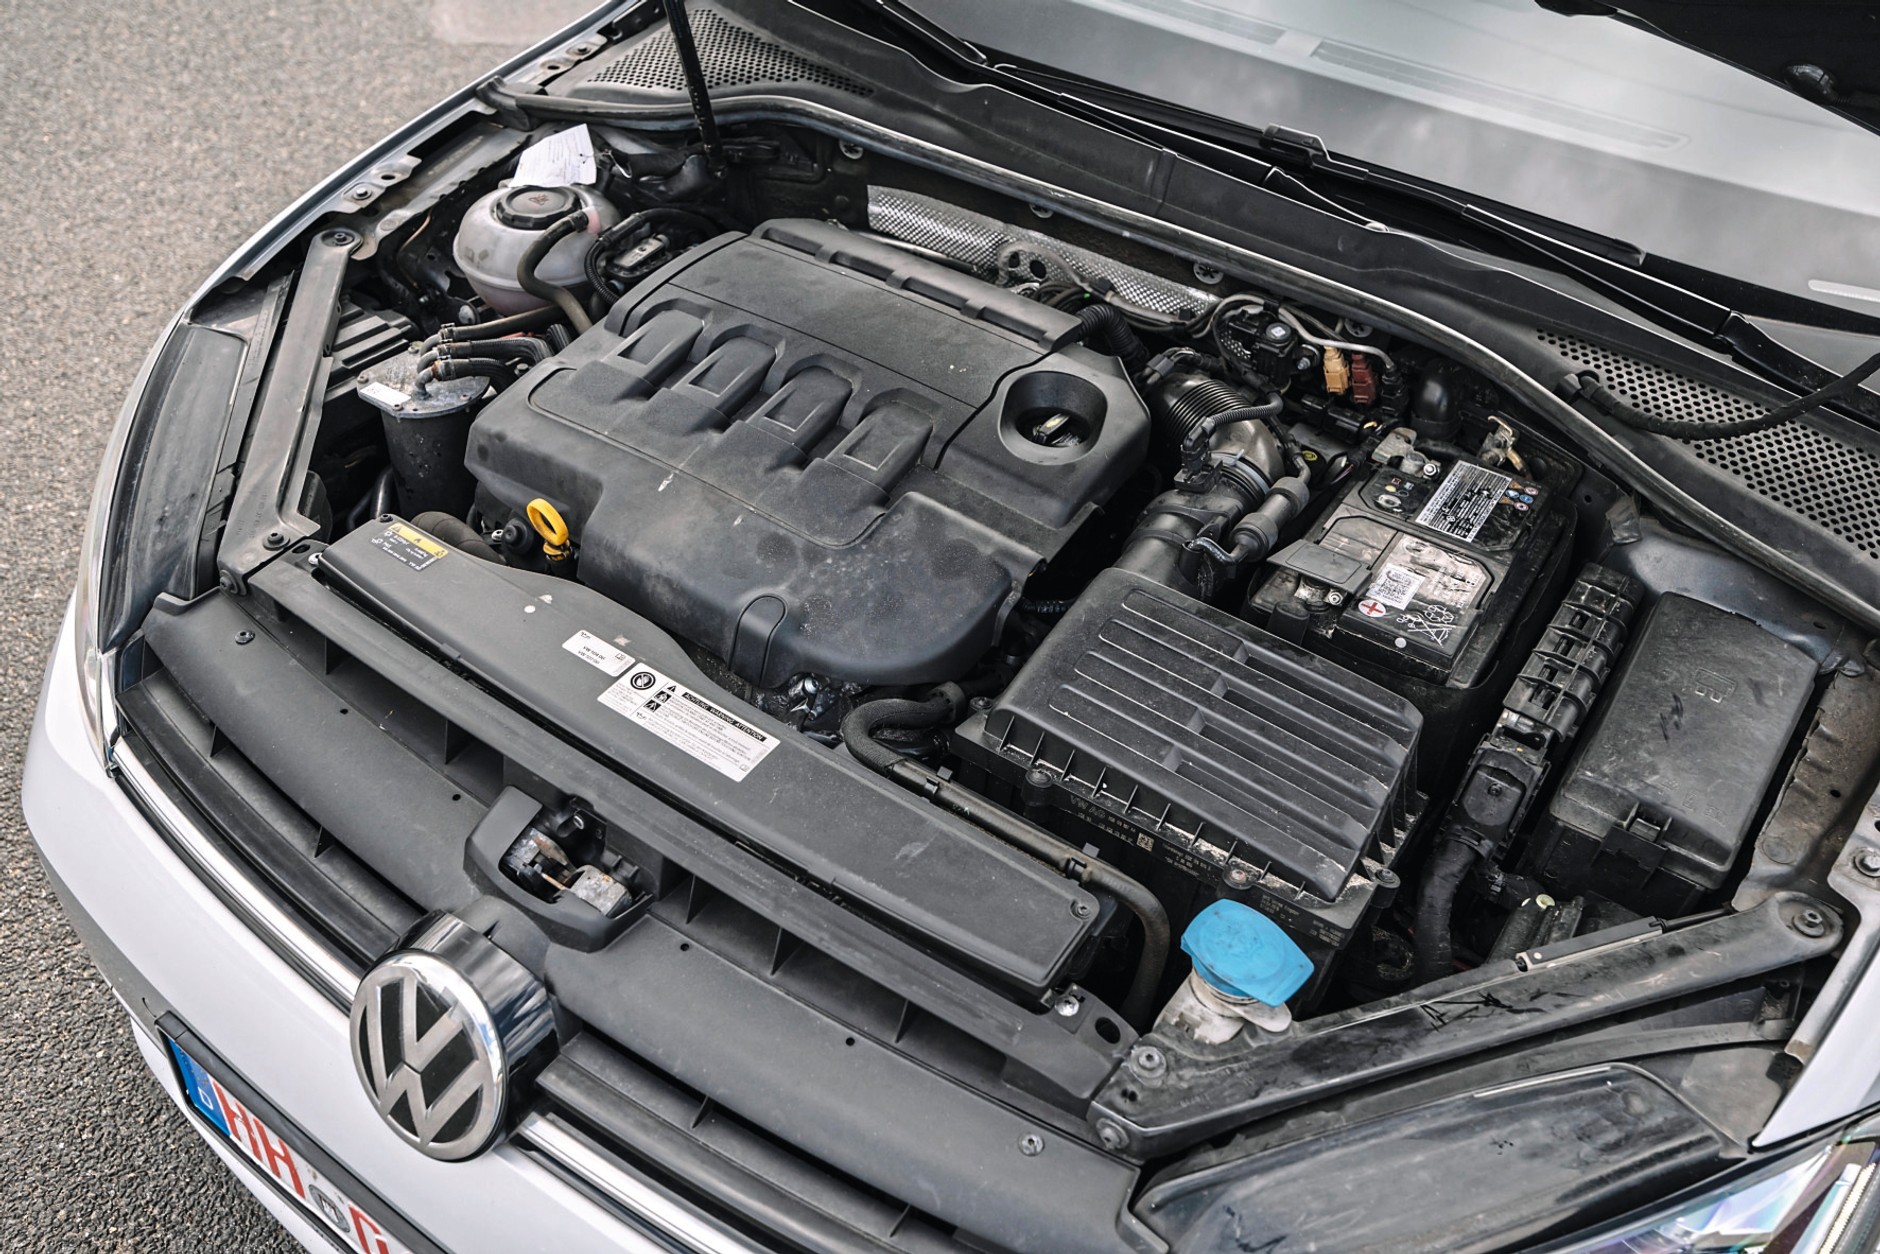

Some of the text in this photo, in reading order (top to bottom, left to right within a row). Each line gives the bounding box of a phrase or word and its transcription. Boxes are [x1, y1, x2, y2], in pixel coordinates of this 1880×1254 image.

[683, 692, 765, 741] ACHTUNG WARNING ATTENTION
[198, 1086, 214, 1111] D
[211, 1079, 306, 1199] HH
